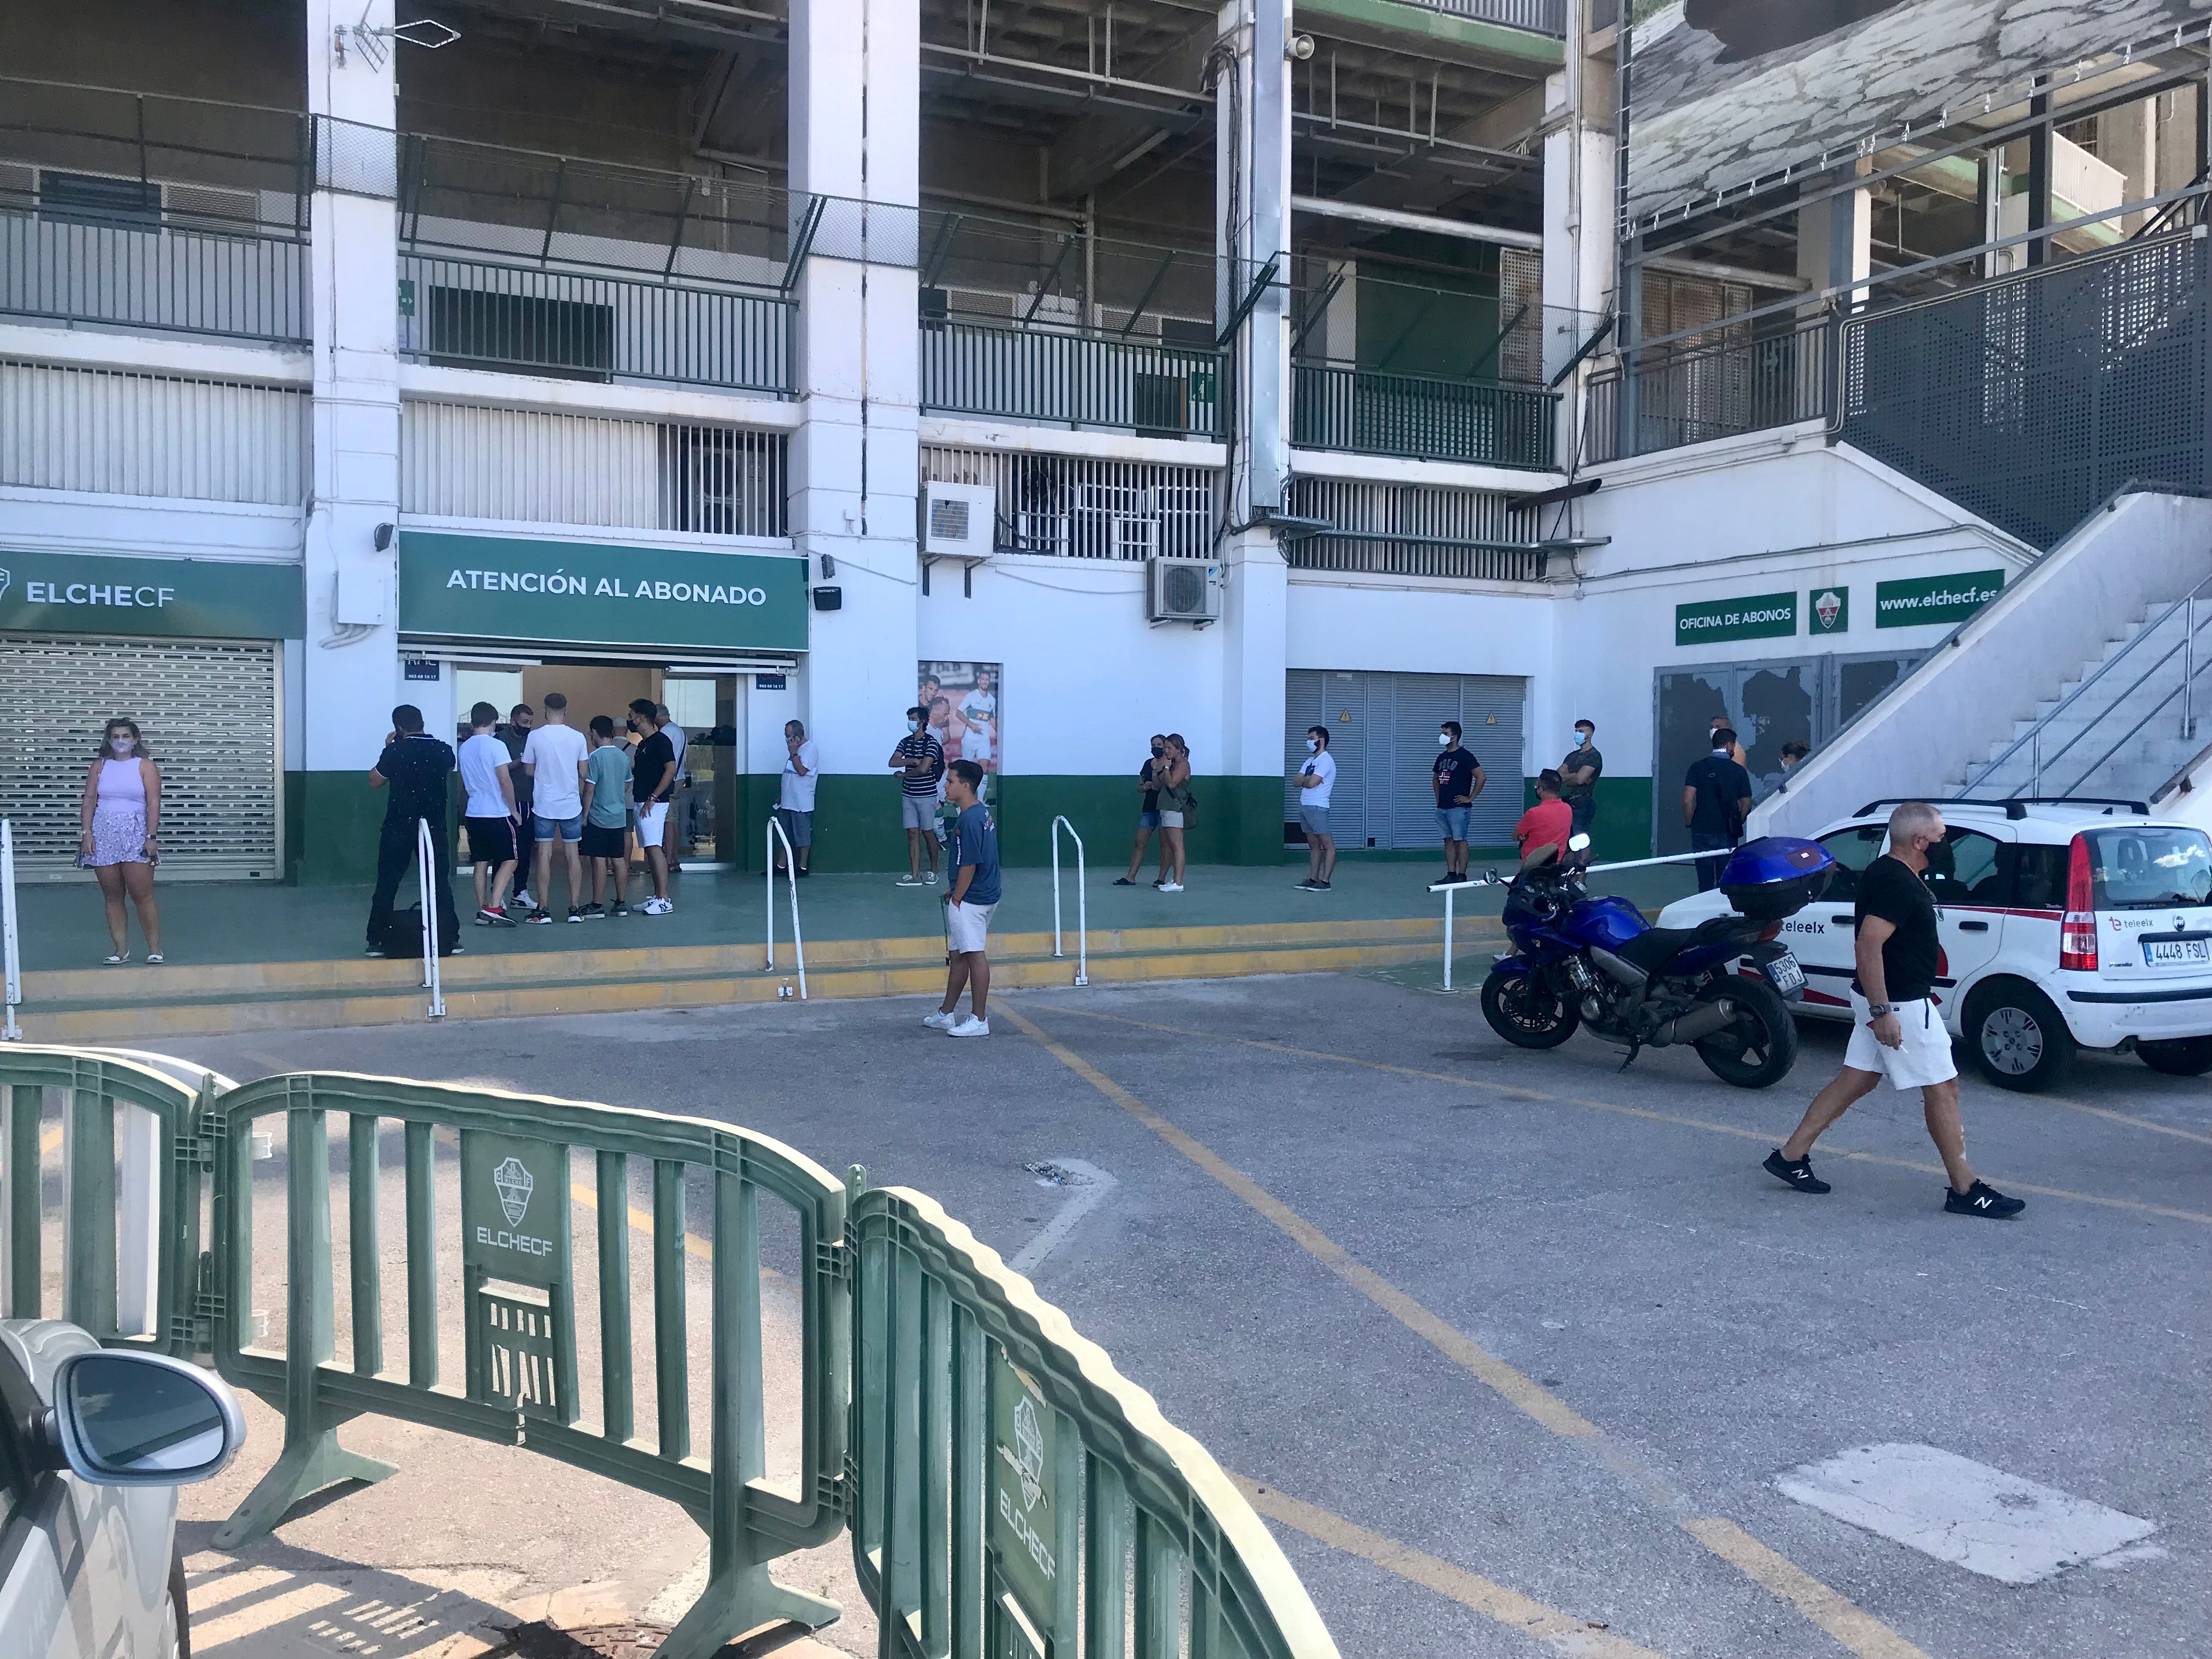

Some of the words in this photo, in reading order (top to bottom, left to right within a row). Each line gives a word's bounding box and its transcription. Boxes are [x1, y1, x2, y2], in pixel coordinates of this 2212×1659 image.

[27, 581, 174, 607] ELCHECF
[446, 568, 586, 595] ATENCIÓN
[594, 578, 629, 598] AL
[635, 580, 766, 606] ABONADO
[1680, 616, 1722, 630] OFICINA
[1725, 613, 1740, 625] DE
[1742, 607, 1791, 624] ABONOS
[2124, 918, 2153, 928] teleelx
[2156, 944, 2183, 961] 4448
[2185, 943, 2206, 959] FSL
[1773, 956, 1796, 974] 5306
[1782, 969, 1802, 987] FDJ
[477, 1226, 552, 1256] ELCHECF
[1000, 1487, 1056, 1581] ELCHECF
